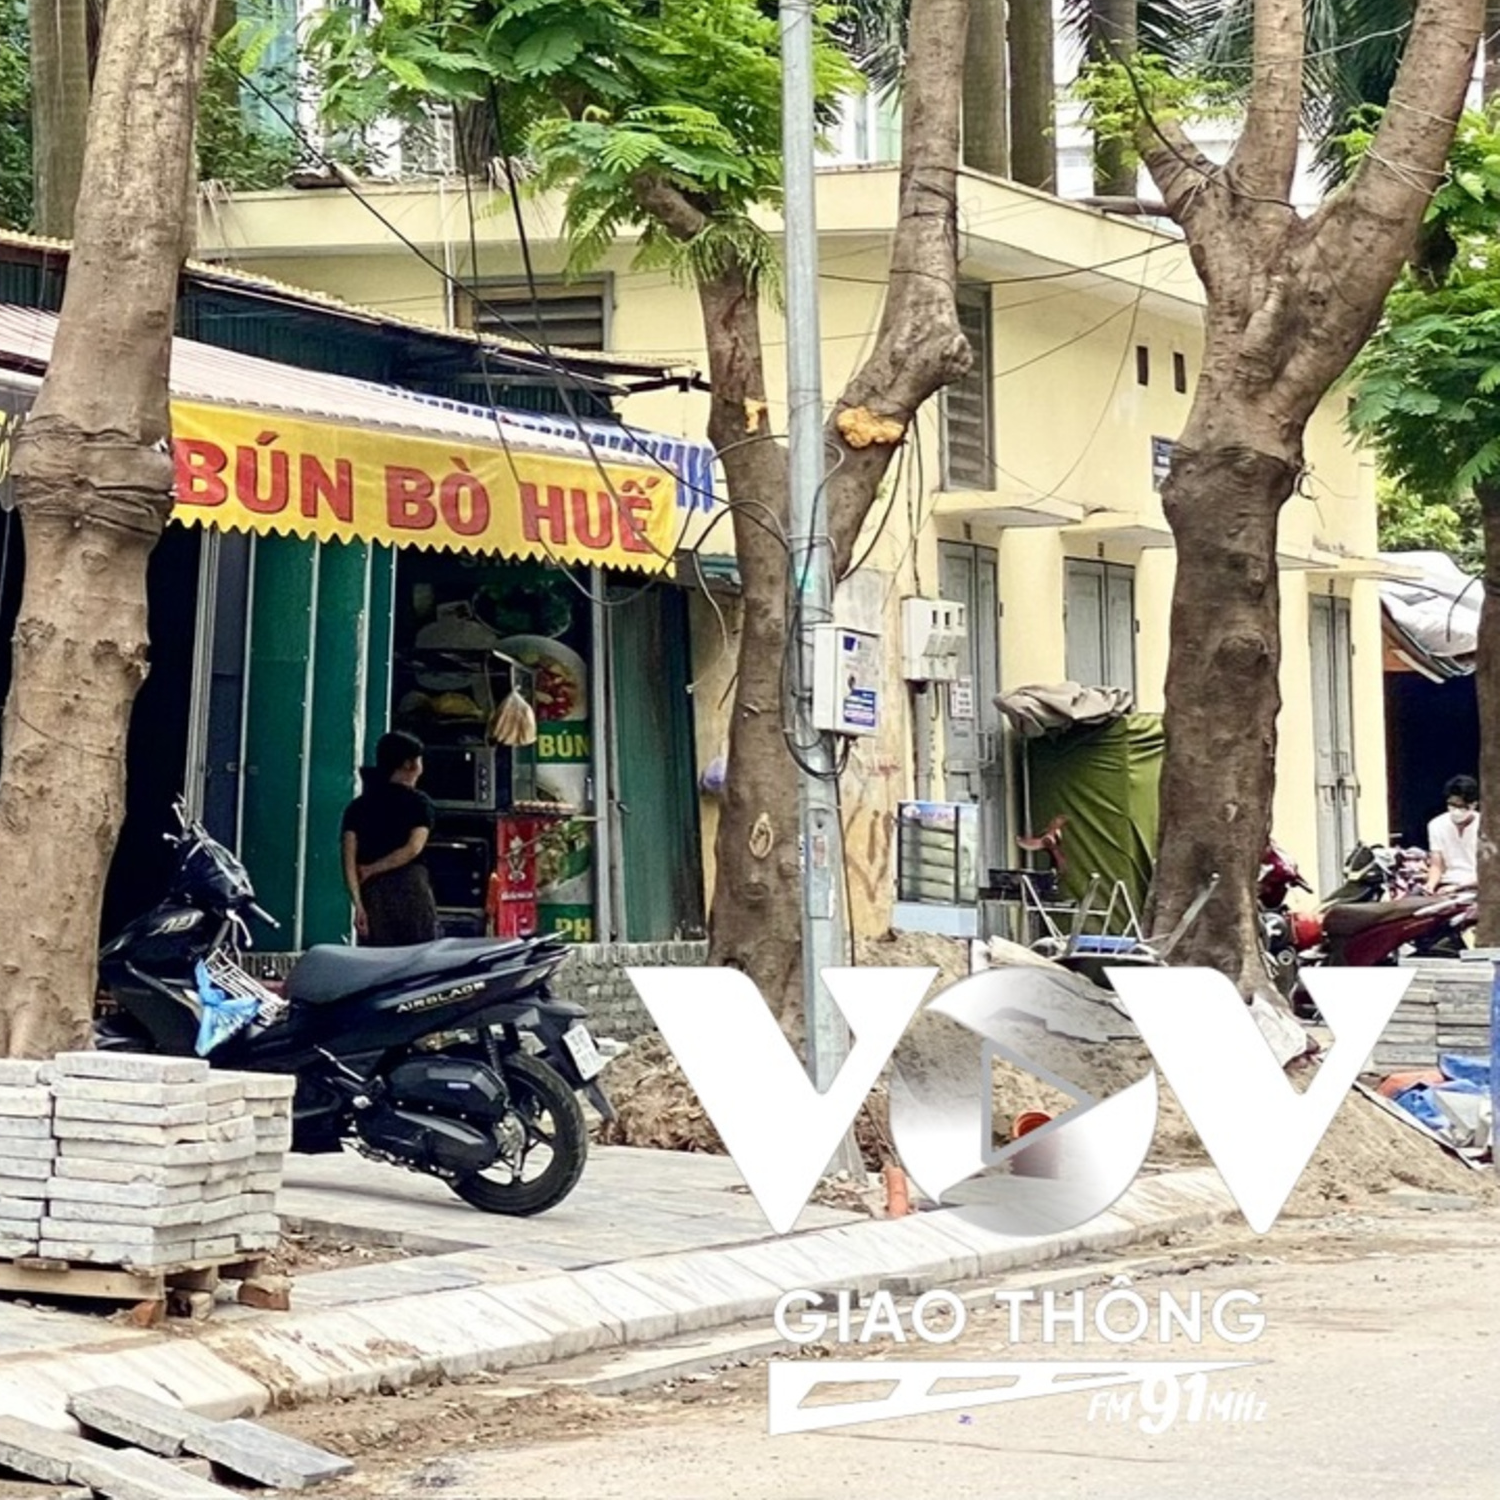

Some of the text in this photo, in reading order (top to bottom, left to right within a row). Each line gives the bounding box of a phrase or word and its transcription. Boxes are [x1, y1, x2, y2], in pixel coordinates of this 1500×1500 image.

[173, 430, 661, 554] BÚN BÒ HUẾ
